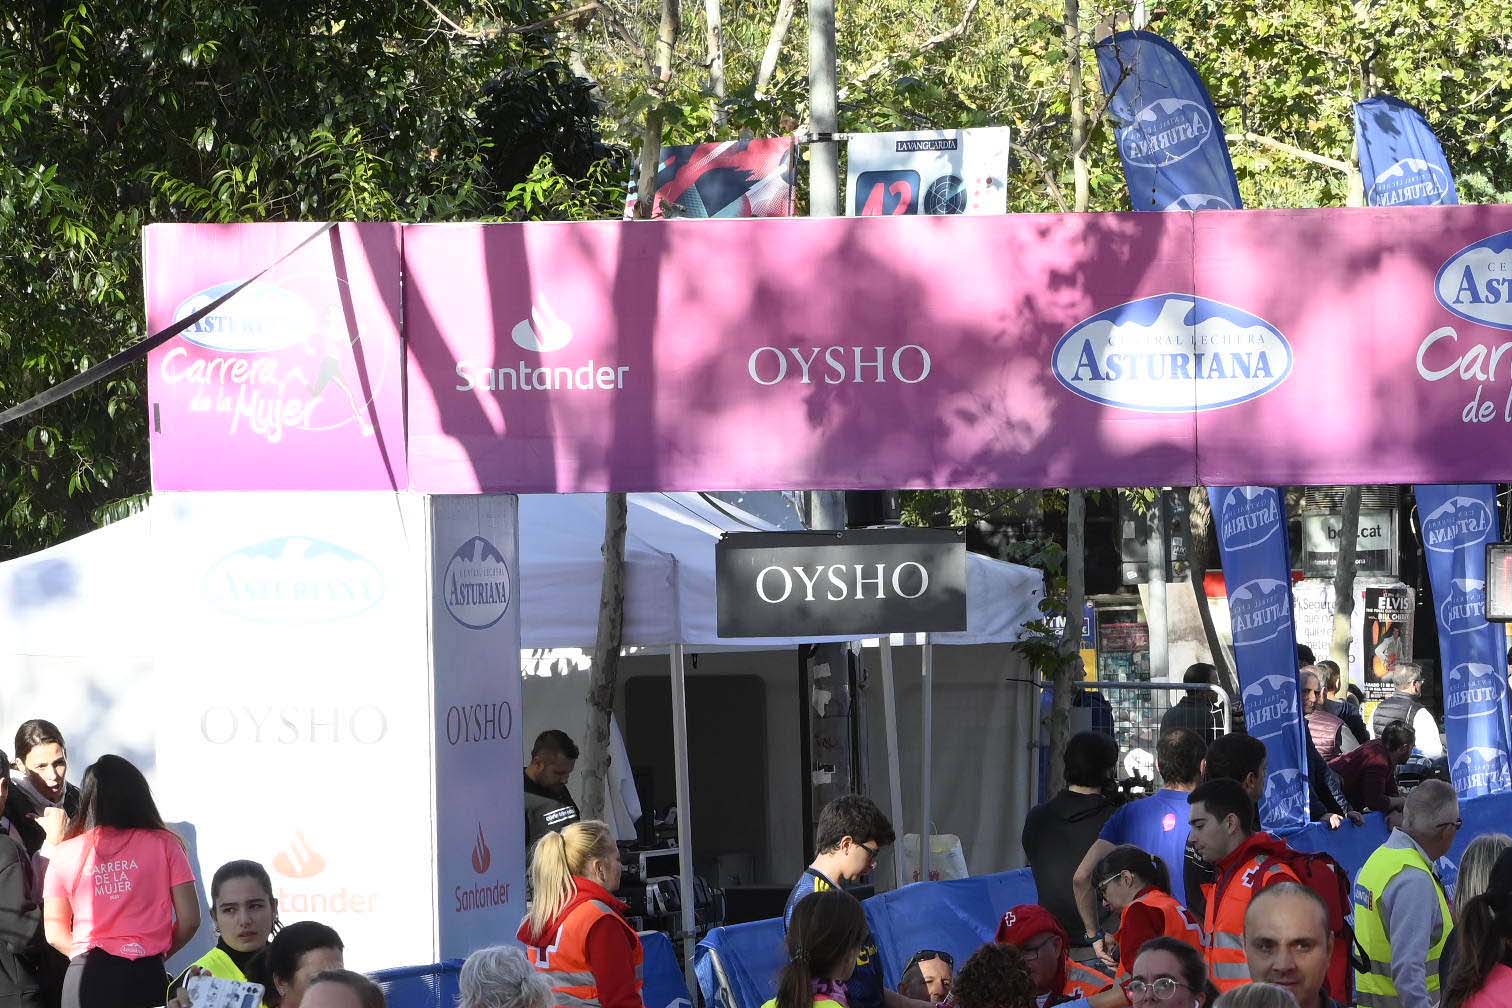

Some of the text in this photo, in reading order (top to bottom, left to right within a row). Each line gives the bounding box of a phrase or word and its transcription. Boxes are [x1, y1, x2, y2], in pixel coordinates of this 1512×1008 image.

[455, 360, 629, 392] Santander
[748, 344, 931, 385] OYSHO
[1070, 340, 1274, 381] ASTURIANA
[1463, 386, 1494, 422] de
[449, 572, 507, 607] ASTURIANA
[756, 561, 928, 603] OYSHO
[1378, 597, 1408, 609] ELVIS
[200, 704, 388, 744] OYSHO
[447, 701, 511, 745] OYSHO
[94, 873, 112, 886] DE
[94, 881, 133, 896] MUJER
[455, 880, 510, 912] Santander
